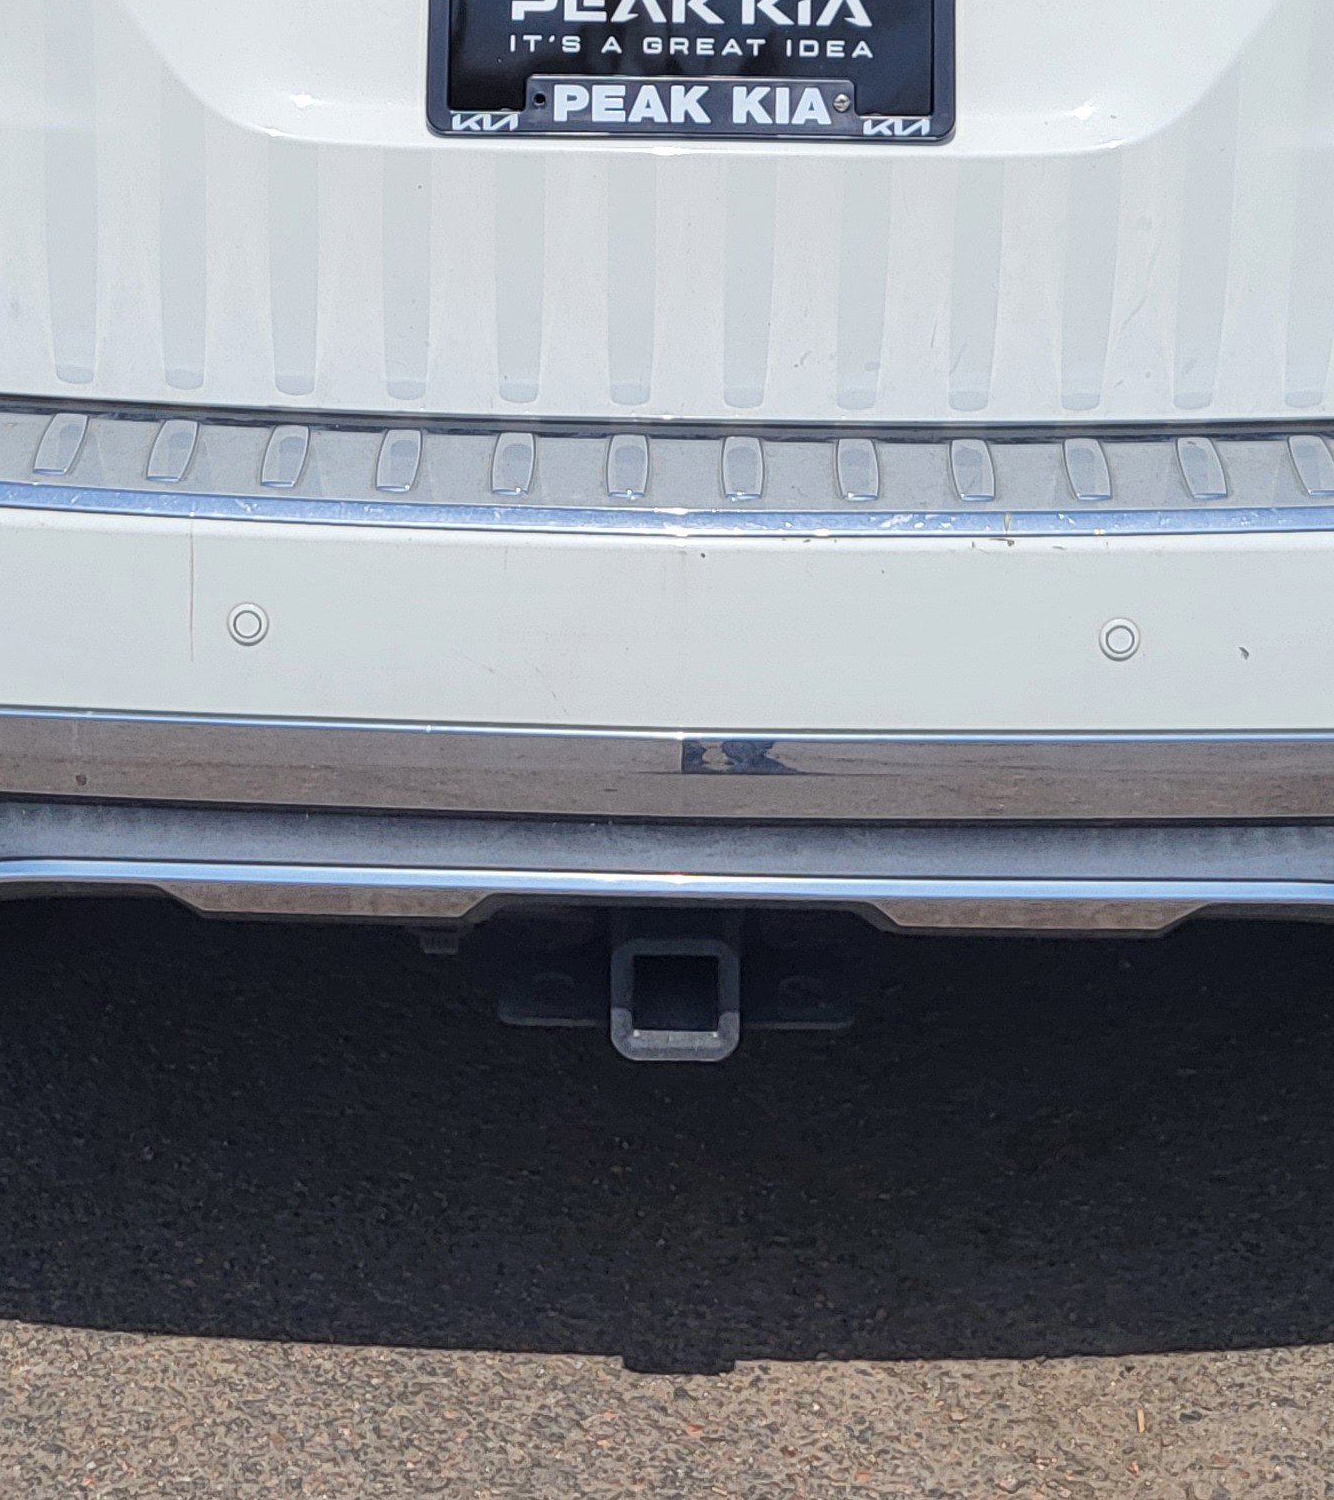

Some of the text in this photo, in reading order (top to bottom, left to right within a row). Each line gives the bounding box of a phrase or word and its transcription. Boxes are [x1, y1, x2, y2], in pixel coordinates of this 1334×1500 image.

[510, 34, 874, 59] IT'S A GREAT IDEA
[553, 84, 832, 126] PEAK KIA
